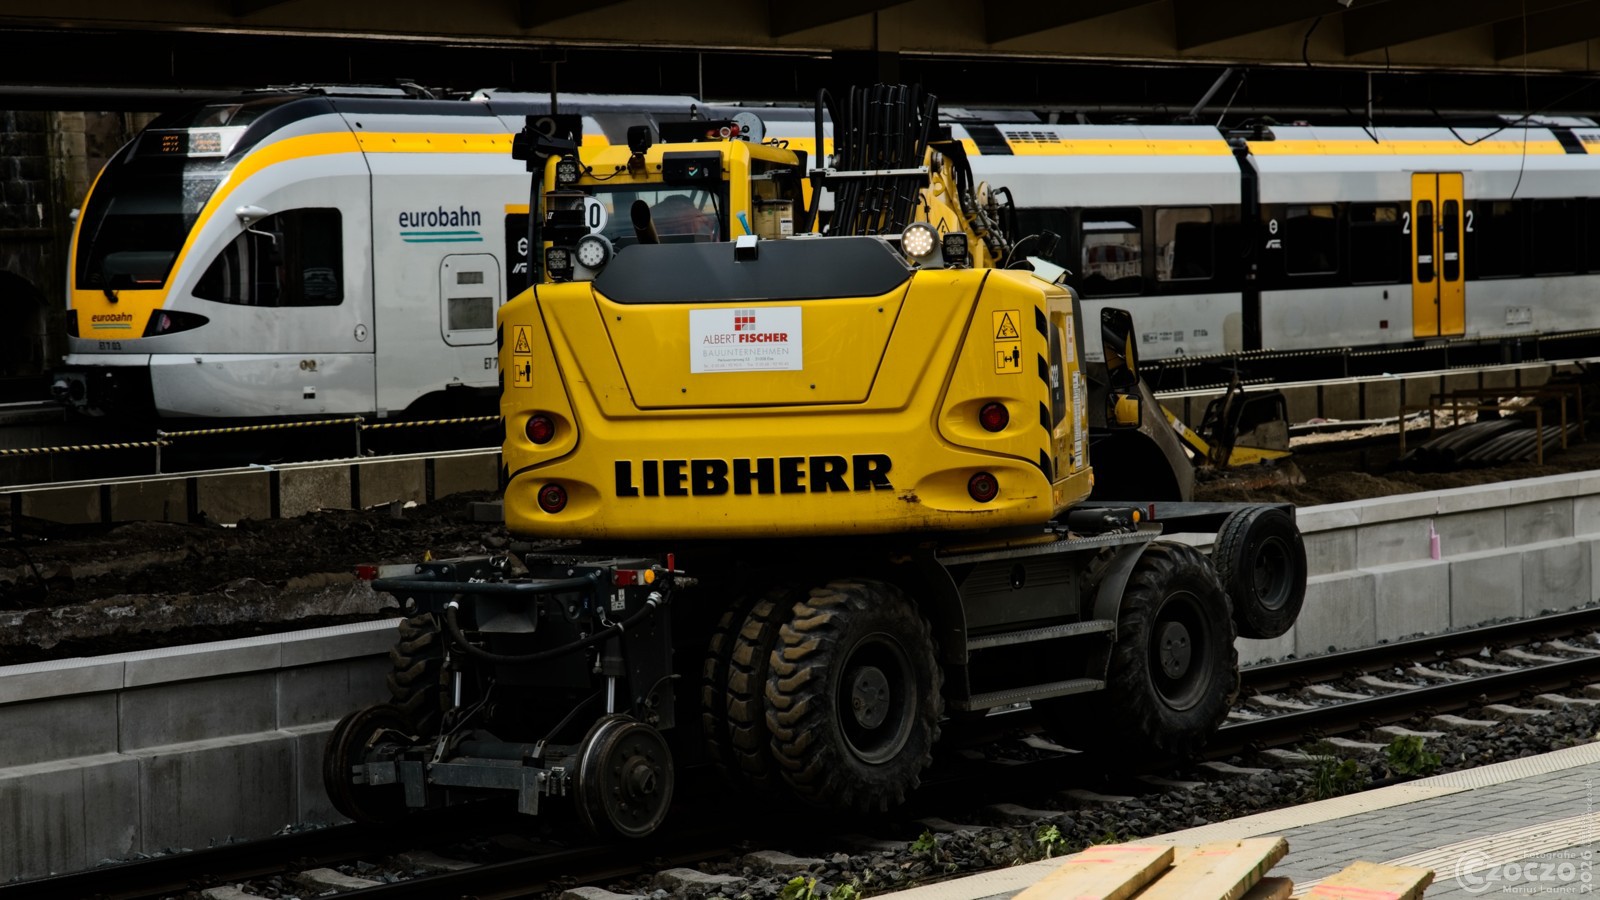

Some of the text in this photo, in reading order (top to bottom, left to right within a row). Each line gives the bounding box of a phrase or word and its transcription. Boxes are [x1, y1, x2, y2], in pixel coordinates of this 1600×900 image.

[399, 206, 481, 227] eurobahn
[1402, 211, 1410, 234] 2
[1466, 210, 1474, 232] 2
[92, 312, 132, 322] eurobahn
[703, 333, 788, 344] ALBERT FISCHER
[702, 347, 789, 357] BAUUNTERNEHMEN
[615, 454, 894, 497] LIEBHERR
